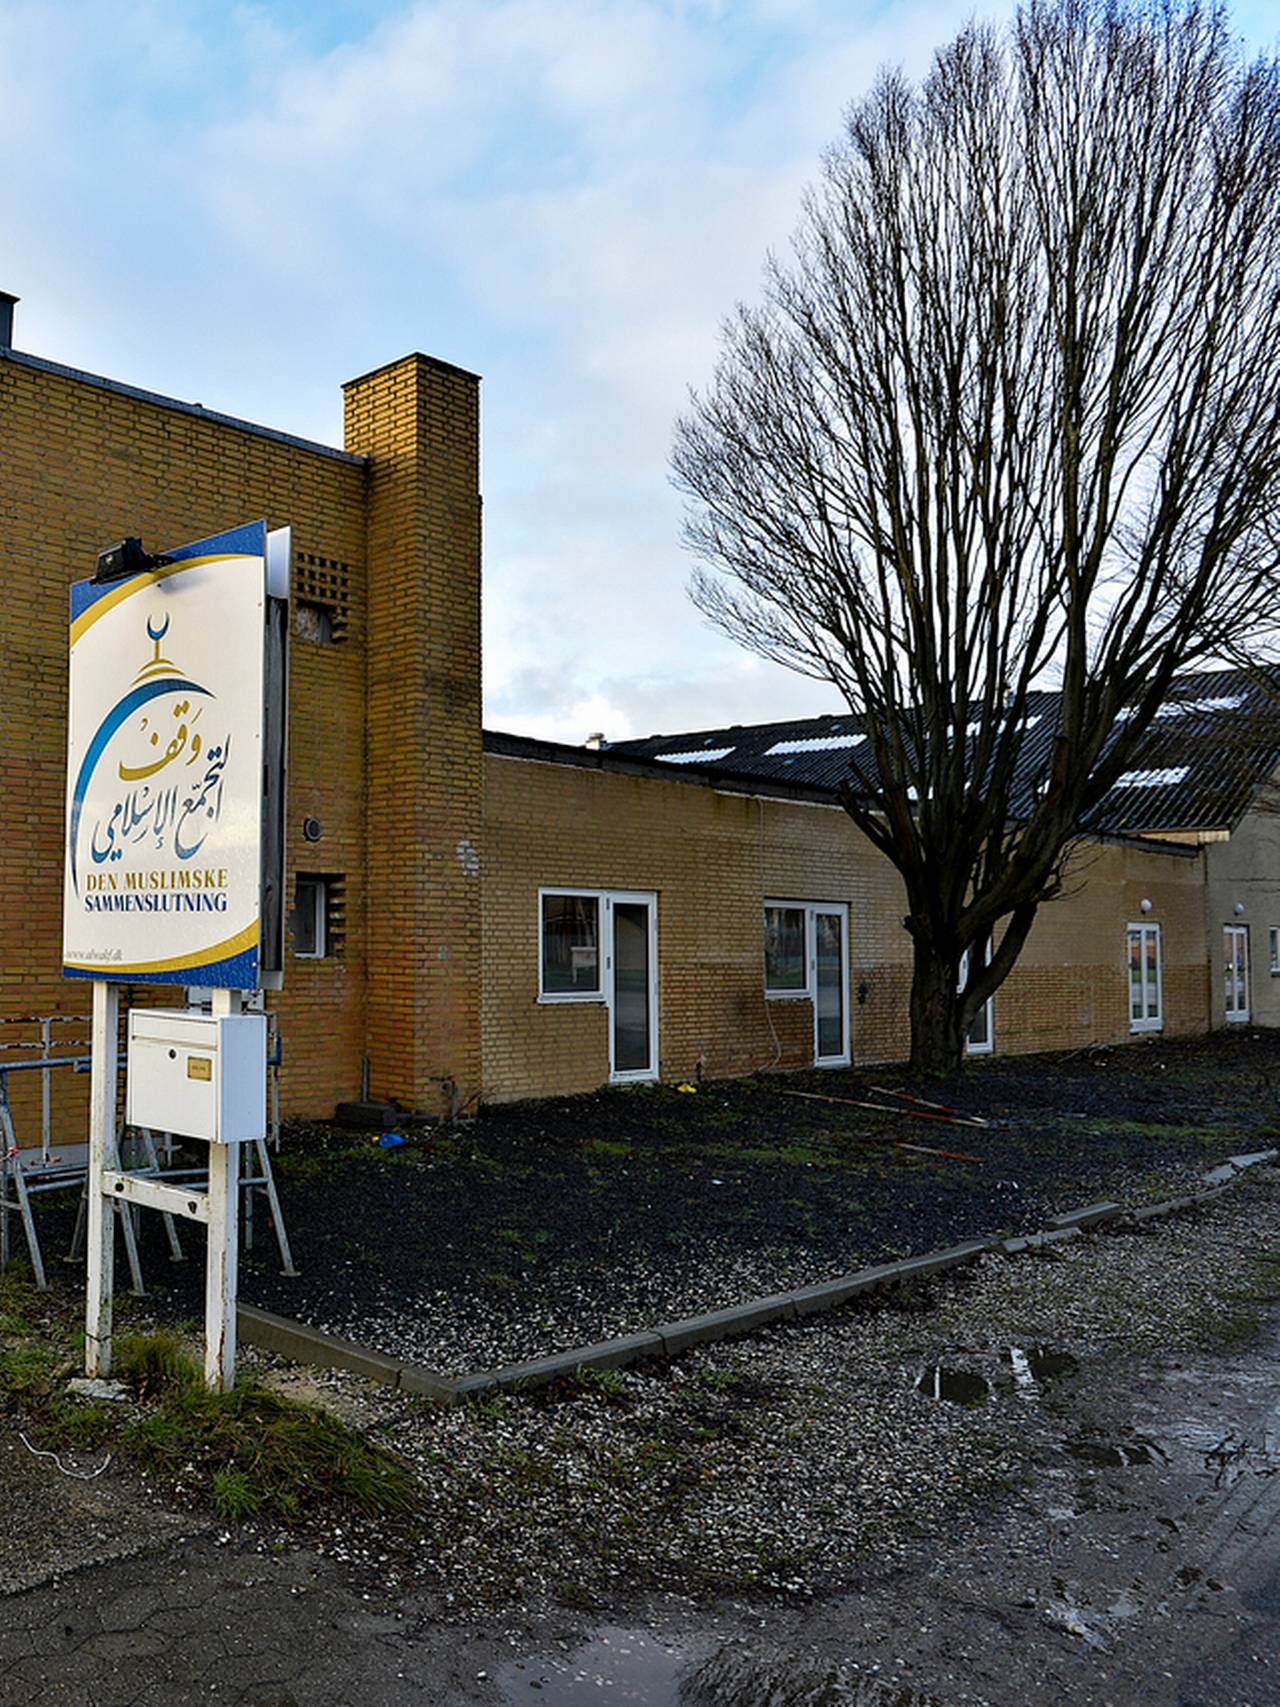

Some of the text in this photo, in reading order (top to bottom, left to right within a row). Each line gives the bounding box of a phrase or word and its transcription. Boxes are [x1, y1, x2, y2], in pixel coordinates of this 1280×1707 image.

[86, 868, 228, 891] DEN MUSLIMSKE
[84, 891, 228, 912] SAMMENSLUTNING
